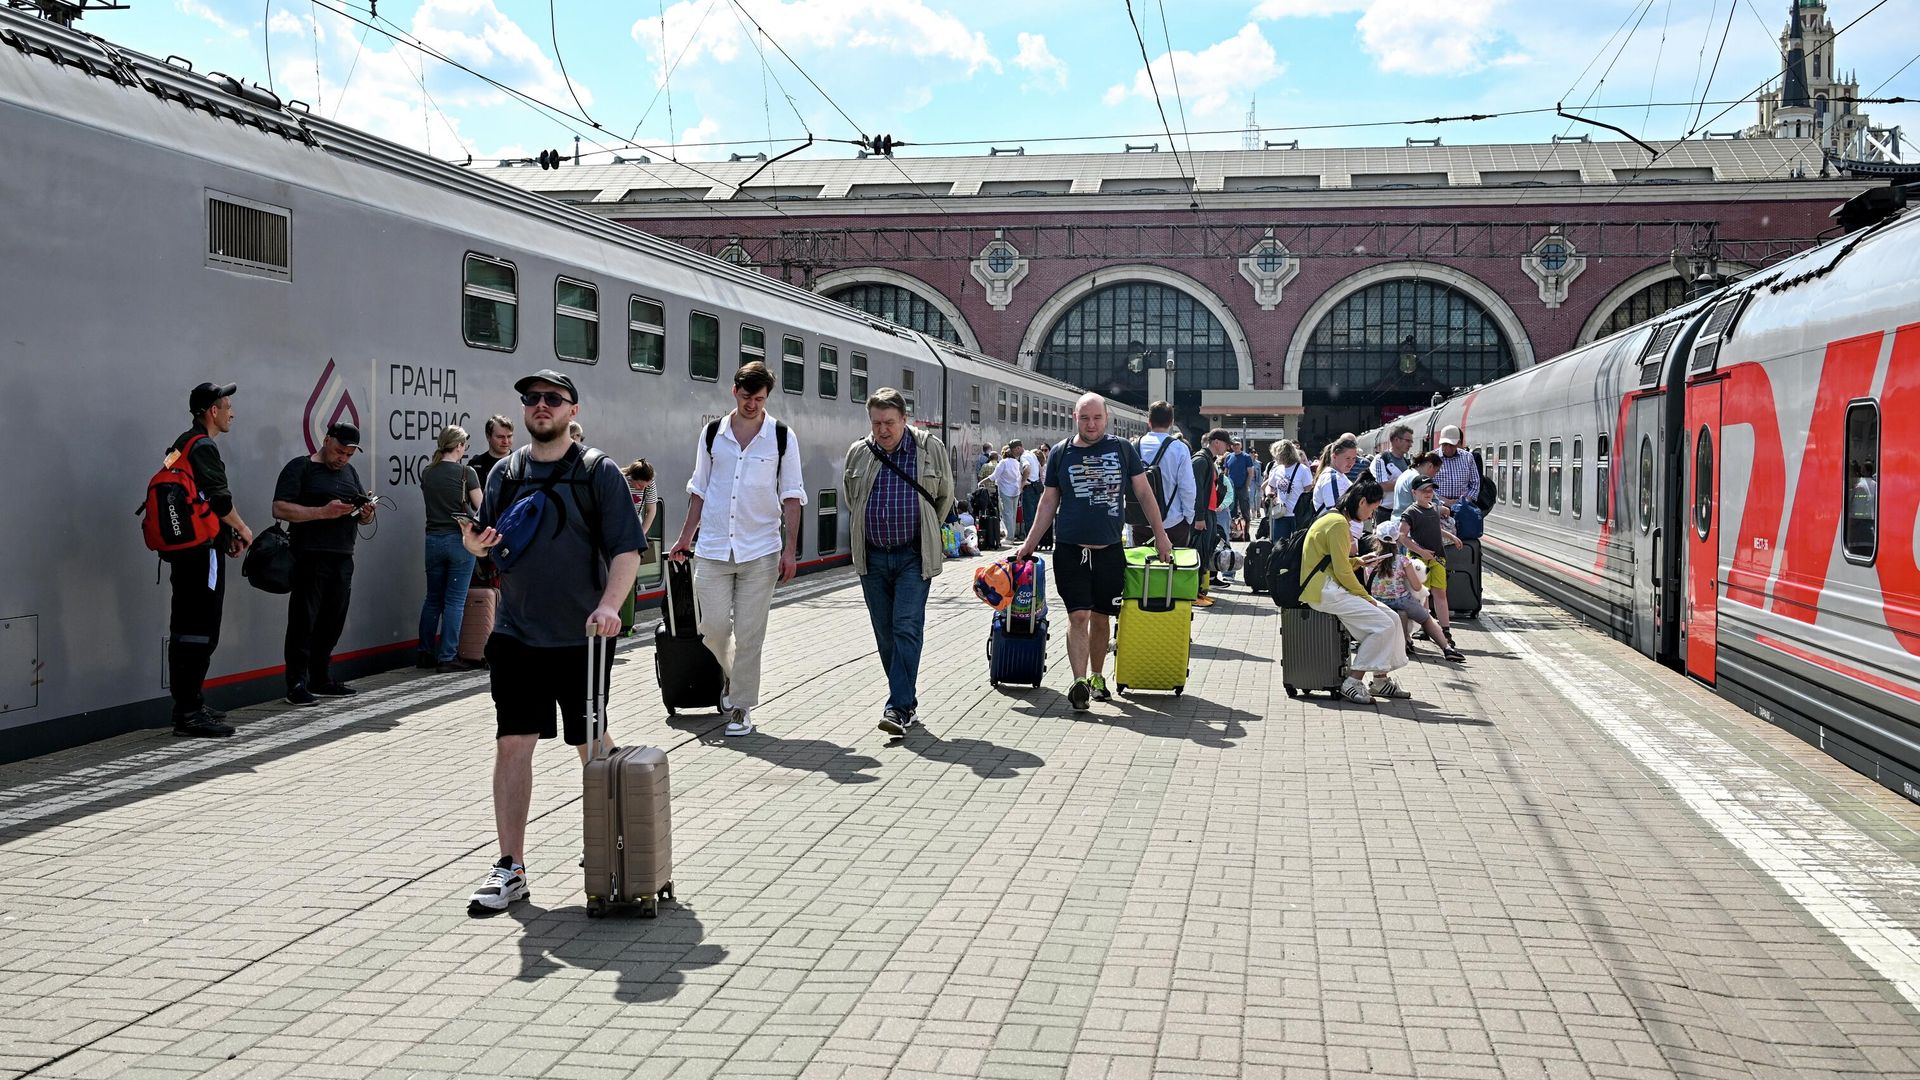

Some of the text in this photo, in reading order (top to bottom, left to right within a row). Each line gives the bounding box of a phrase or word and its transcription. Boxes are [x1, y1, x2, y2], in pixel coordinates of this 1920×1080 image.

[390, 363, 458, 404] ГРАНД
[1068, 464, 1092, 498] INTO
[1101, 451, 1122, 517] AMERICA
[168, 504, 181, 536] adidas
